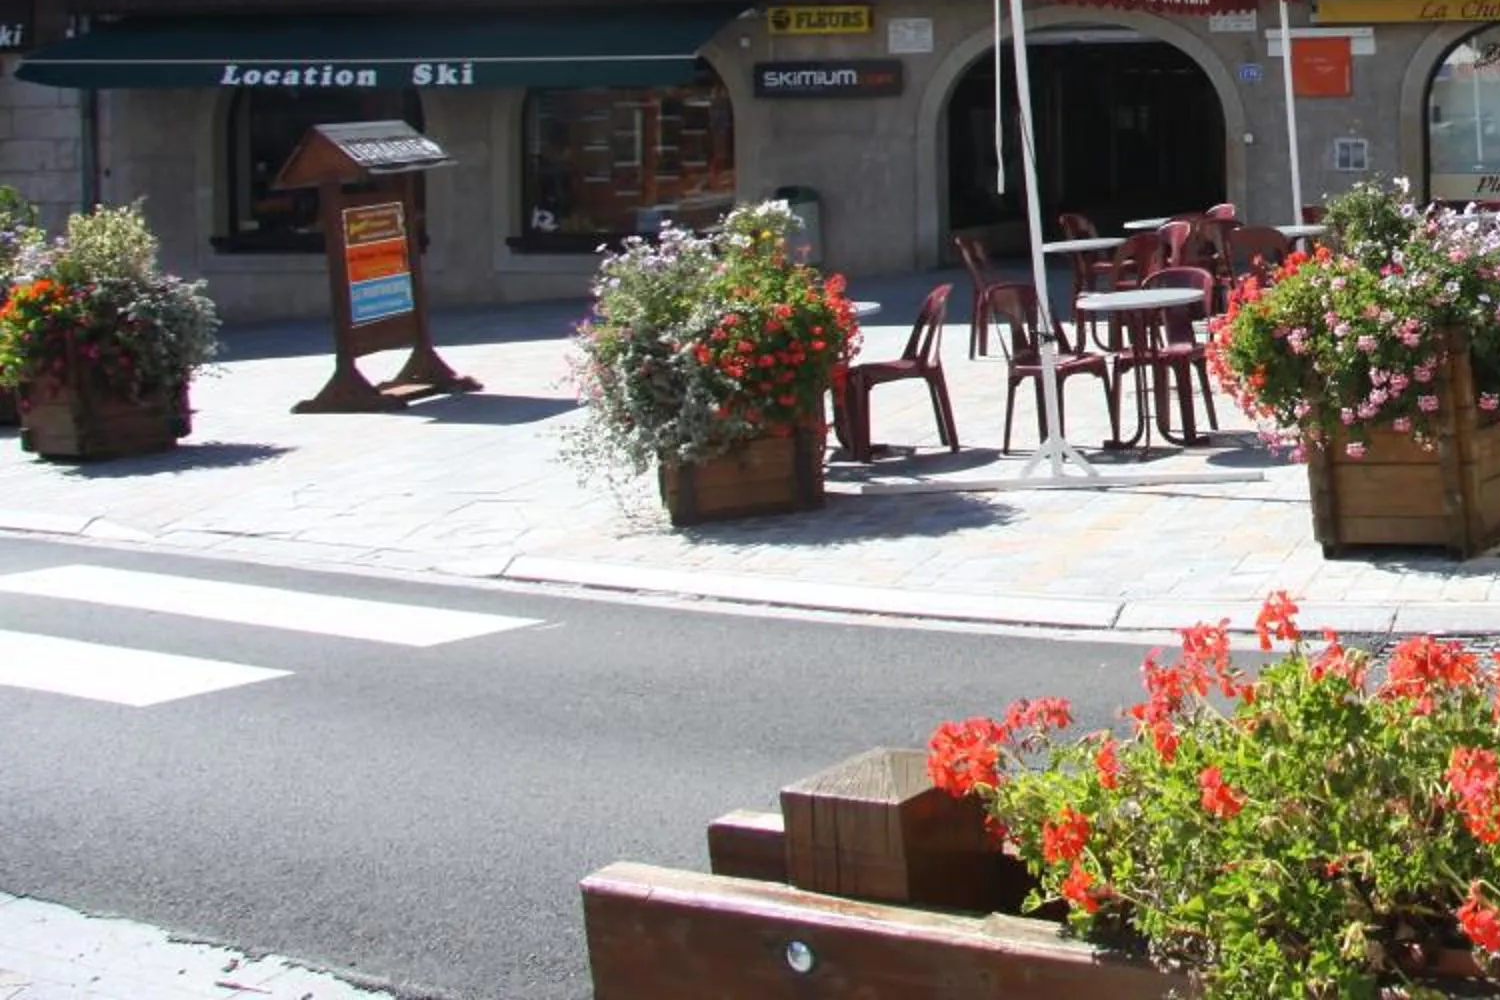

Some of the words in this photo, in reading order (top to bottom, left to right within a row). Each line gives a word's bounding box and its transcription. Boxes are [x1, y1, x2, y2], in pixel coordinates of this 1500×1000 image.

[796, 9, 864, 30] FLEURS
[1418, 0, 1448, 19] La
[220, 64, 377, 87] Location
[412, 62, 474, 86] Ski
